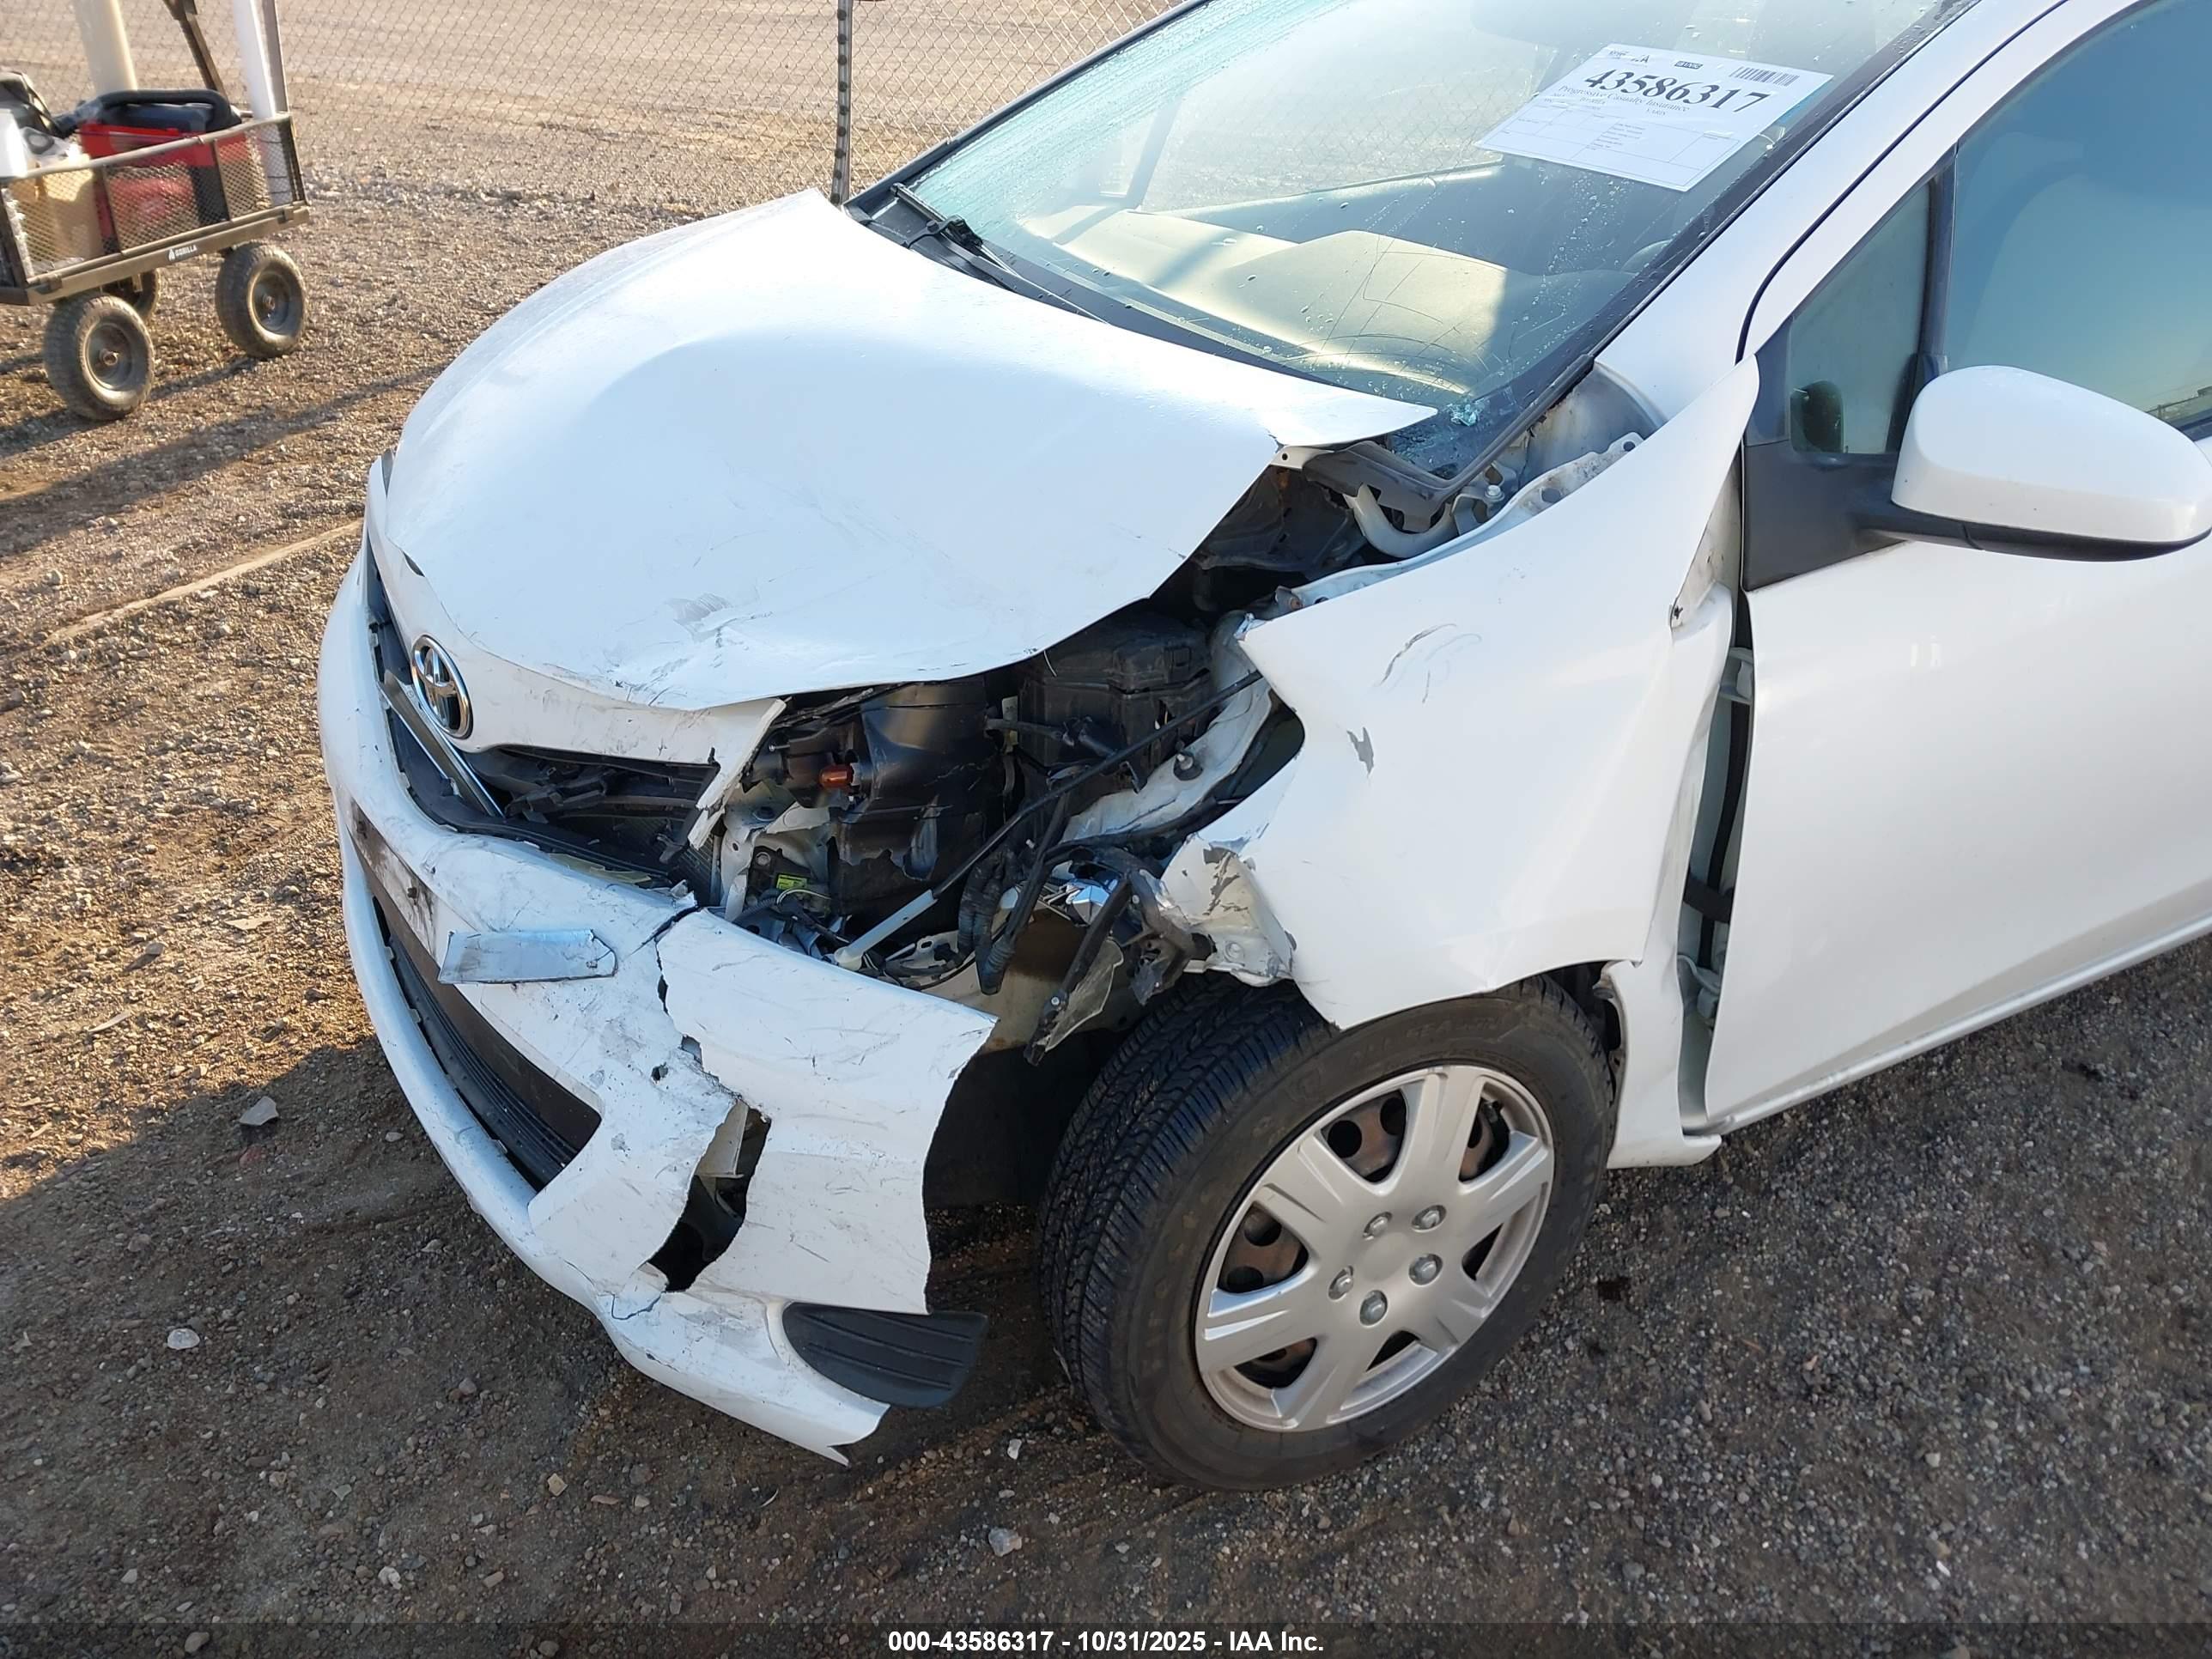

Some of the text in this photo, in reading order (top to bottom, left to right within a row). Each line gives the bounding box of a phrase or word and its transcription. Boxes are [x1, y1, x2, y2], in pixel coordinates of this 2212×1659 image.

[1558, 85, 1607, 98] Progressive
[1607, 92, 1644, 104] Casualty
[1645, 99, 1690, 112] Insurance
[1584, 69, 1771, 112] 43586317
